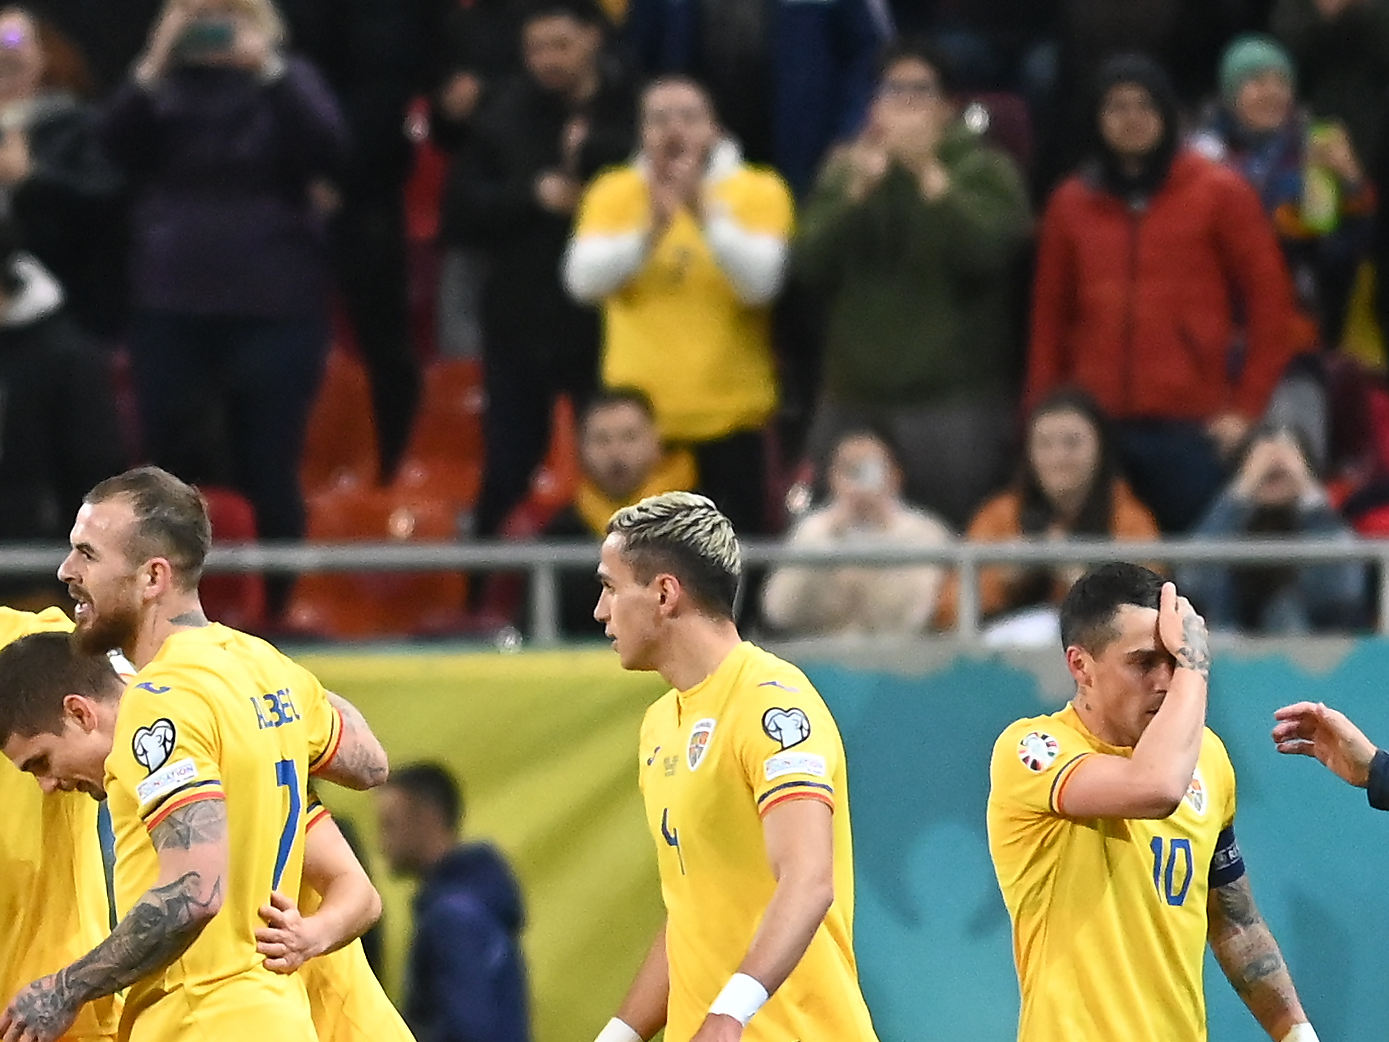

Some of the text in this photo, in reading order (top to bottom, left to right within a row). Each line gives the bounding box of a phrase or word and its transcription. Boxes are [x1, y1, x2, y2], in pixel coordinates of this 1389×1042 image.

[271, 758, 302, 892] 7
[660, 807, 686, 876] 4
[1149, 835, 1194, 907] 10
